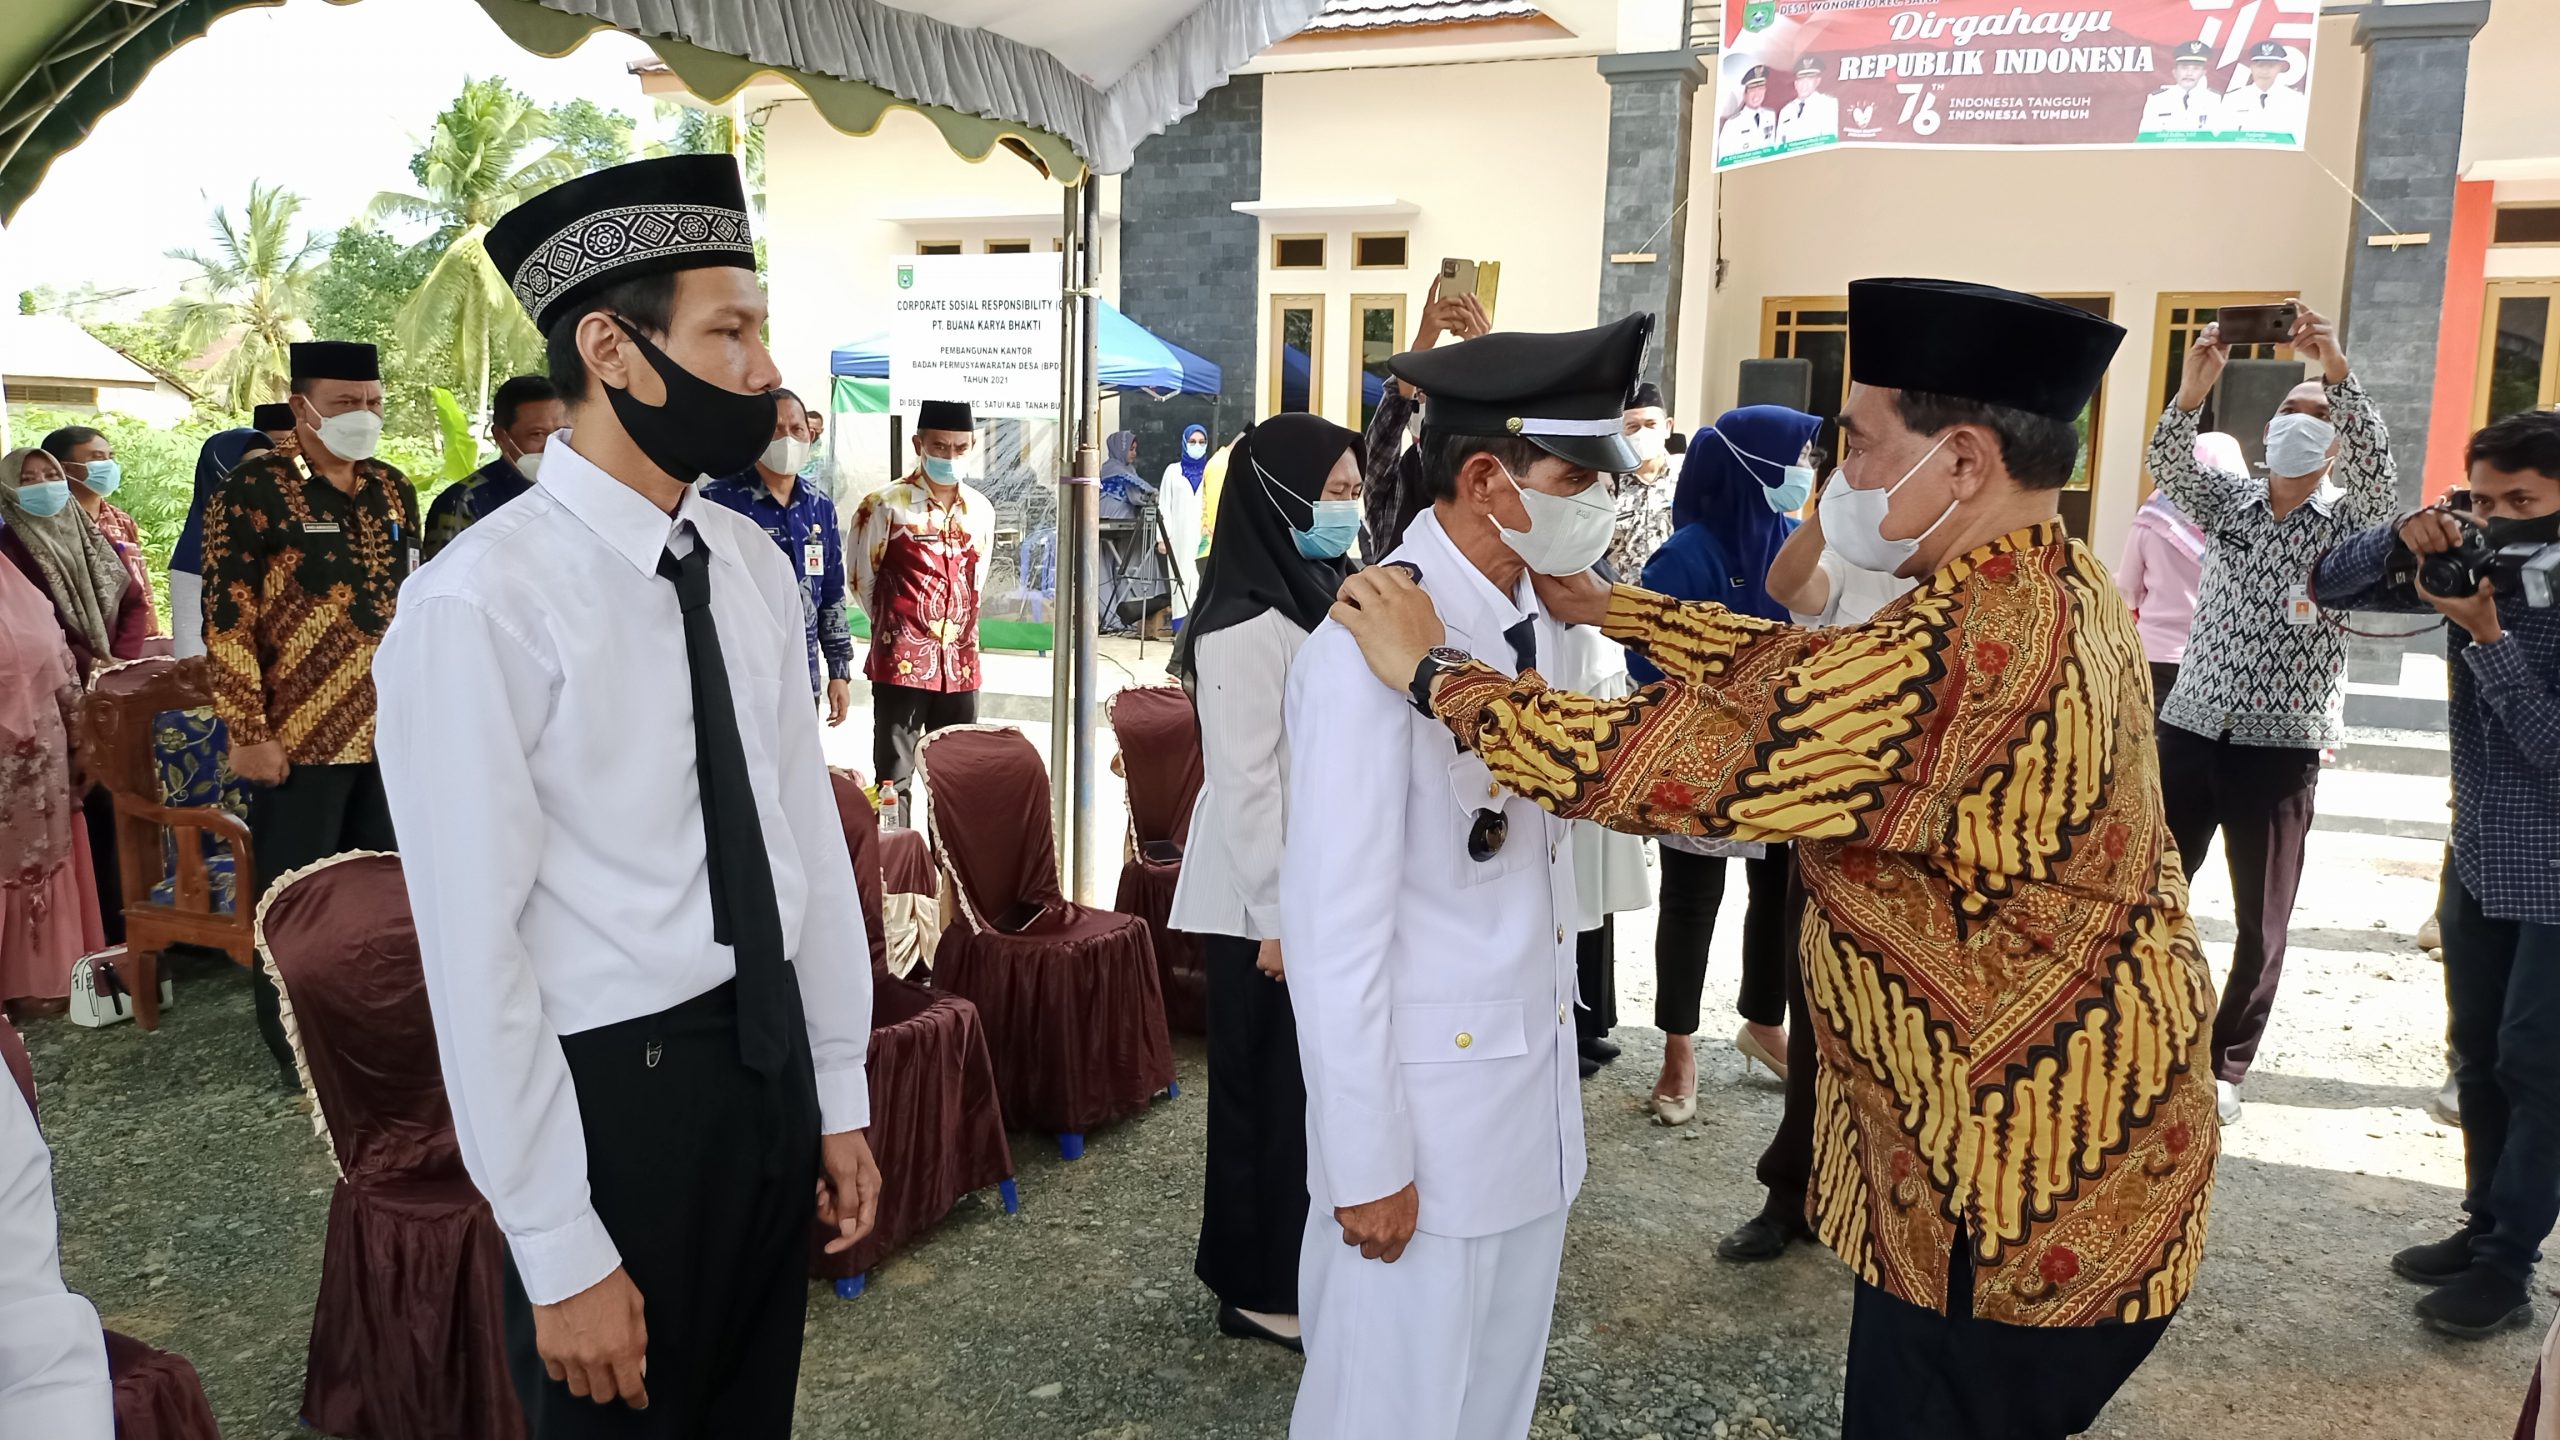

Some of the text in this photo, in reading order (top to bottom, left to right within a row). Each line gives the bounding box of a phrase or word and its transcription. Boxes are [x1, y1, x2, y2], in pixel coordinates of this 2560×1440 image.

[1780, 3, 1806, 15] DESA
[1888, 7, 2113, 46] Dirgahayu
[1838, 46, 2154, 80] REPUBLIK INDONESIA
[1949, 96, 2091, 109] INDONESIA TANGGUH
[1896, 83, 1941, 136] 76
[1948, 109, 2090, 120] INDONESIA TUMBUH
[897, 300, 946, 311] CORPORATE
[949, 300, 979, 311] SOSIAL
[981, 299, 1052, 311] RESPONSIBILITY
[932, 319, 1041, 330] PT. BUANA KARYA BHAKTI
[940, 346, 1032, 355] PEMBANGUNAN KANTOR
[912, 361, 937, 369] BADAN
[939, 361, 1016, 370] PERMUSYAWARATAN
[1019, 361, 1039, 370] DESA
[963, 375, 1008, 384] TAHUN 2021
[984, 400, 1004, 408] SATUI
[1025, 401, 1049, 409] TANAH
